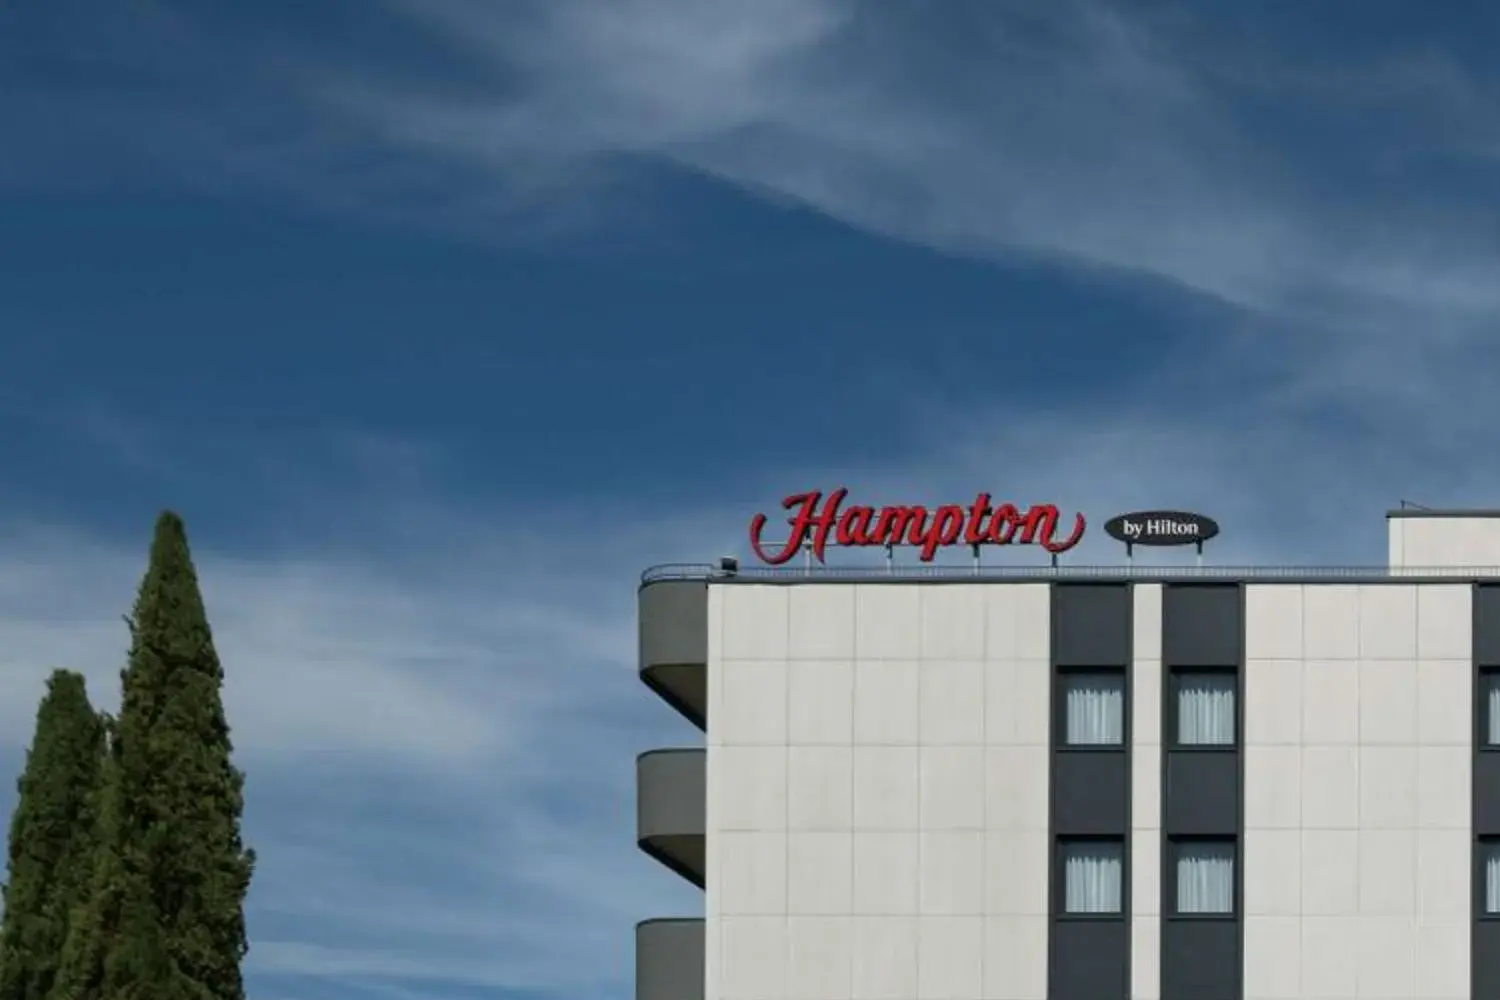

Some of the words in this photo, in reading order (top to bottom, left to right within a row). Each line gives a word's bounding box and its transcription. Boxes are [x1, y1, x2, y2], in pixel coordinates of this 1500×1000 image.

[750, 487, 1085, 565] Hampton
[1123, 519, 1142, 536] by
[1146, 519, 1199, 535] Hilton
